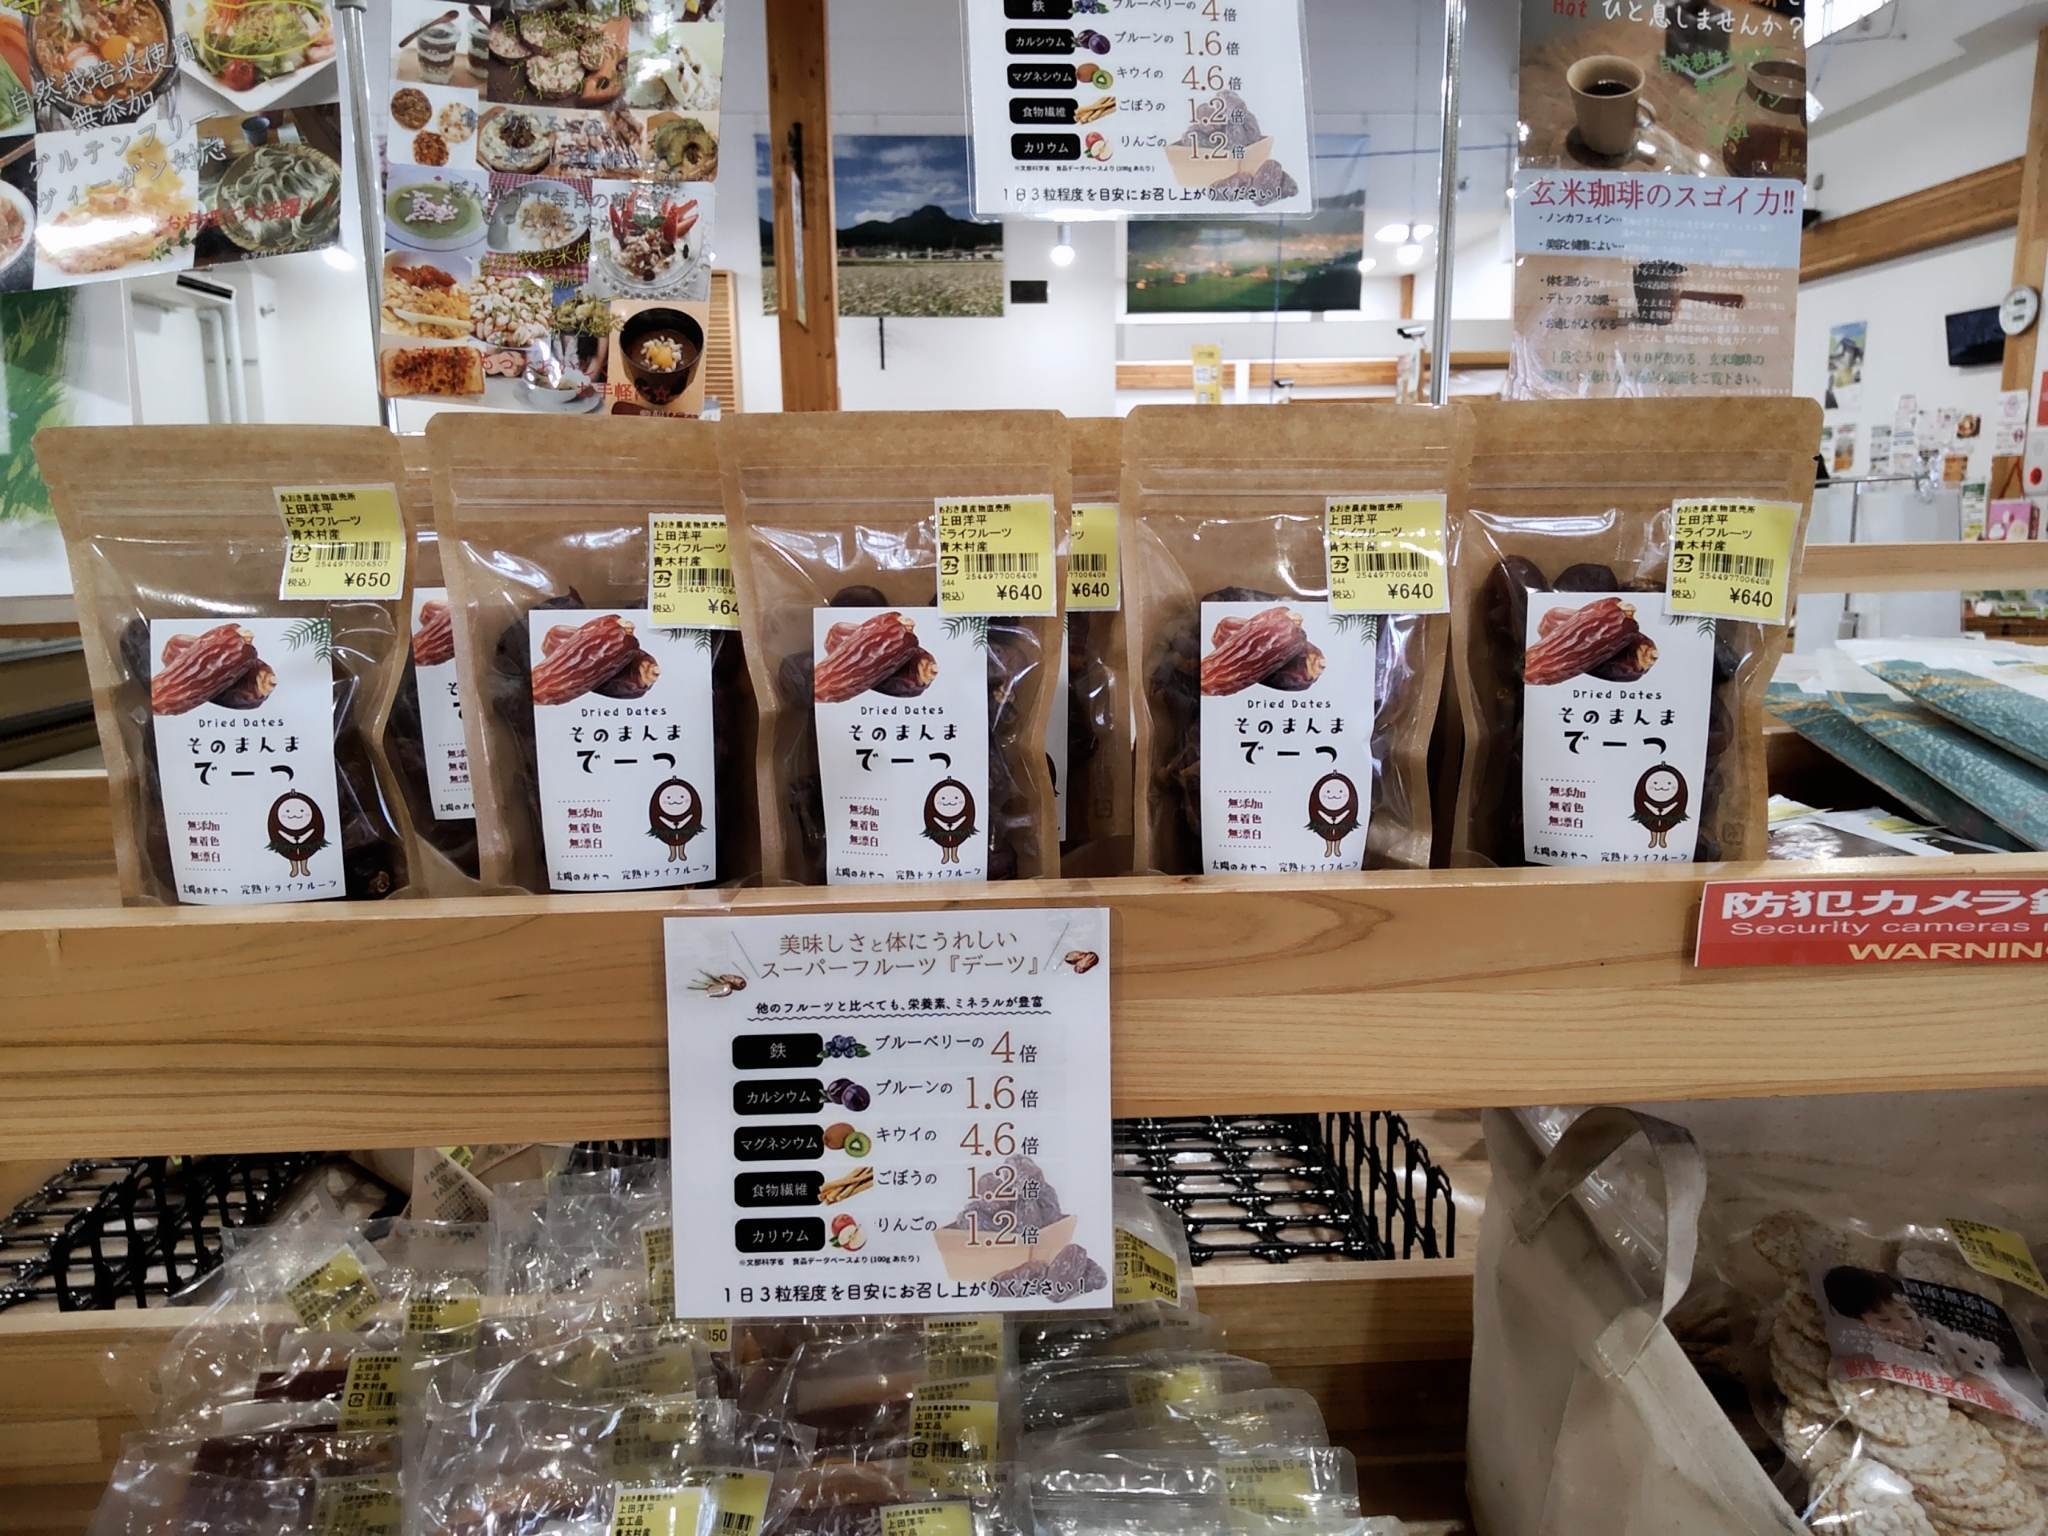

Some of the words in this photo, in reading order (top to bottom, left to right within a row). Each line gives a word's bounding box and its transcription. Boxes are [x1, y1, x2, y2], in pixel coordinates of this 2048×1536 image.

[1602, 1, 1804, 41] ひと息しませんか?
[1015, 36, 1066, 48] カルシウム
[11, 31, 196, 116] 自然栽培米使用
[1012, 70, 1073, 83] マグネシウム
[1116, 67, 1163, 79] キウイの
[71, 89, 156, 136] 無添加
[1022, 106, 1067, 118] 食物繊維
[1120, 100, 1166, 112] ごぼうの
[1024, 142, 1069, 154] カリウム
[1121, 136, 1167, 148] りんごの
[285, 503, 333, 515] 上田洋平
[287, 516, 361, 527] ドライフルーツ
[939, 515, 987, 526] 上田洋平
[1330, 514, 1378, 525] 上田洋平
[1676, 515, 1728, 526] 上田洋平
[292, 530, 340, 540] 青木村産
[654, 531, 701, 541] 上田洋平
[939, 529, 1012, 539] ドライフルーツ
[1675, 528, 1752, 540] ドライフルーツ
[654, 543, 727, 553] ドライフルーツ
[940, 541, 988, 552] 青木村産
[1674, 541, 1726, 551] 青木村産
[654, 557, 702, 567] 青木村産
[344, 572, 391, 588] ¥650
[996, 584, 1042, 601] ¥640
[1072, 582, 1110, 597] ¥640
[1388, 583, 1433, 599] ¥640
[1730, 587, 1773, 608] ¥640
[1573, 690, 1612, 699] Dried
[1619, 690, 1662, 700] Dates
[861, 706, 897, 715] Dried
[904, 706, 944, 715] Dates
[1247, 699, 1284, 709] Dried
[1292, 699, 1331, 708] Dates
[582, 708, 619, 717] Dried
[627, 707, 667, 716] Dates
[1558, 707, 1675, 725] そのまんま
[198, 719, 236, 729] Dried
[243, 718, 284, 727] Dates
[1234, 717, 1344, 734] そのまんま
[569, 725, 681, 743] そのまんま
[849, 724, 958, 741] そのまんま
[187, 736, 300, 754] そのまんま
[1564, 731, 1667, 755] でーつ
[856, 748, 952, 772] でーつ
[1240, 741, 1337, 765] でーつ
[577, 750, 676, 773] でーつ
[194, 762, 295, 785] でーつ
[1549, 786, 1586, 799] 無添加
[849, 804, 880, 817] 無添加
[1227, 798, 1263, 809] 無添加
[1548, 801, 1584, 813] 無着色
[567, 807, 603, 818] 無添加
[1227, 813, 1262, 824] 無着色
[187, 820, 220, 832] 無添加
[568, 823, 602, 833] 無着色
[849, 819, 879, 832] 無着色
[1548, 816, 1583, 829] 無漂白
[1227, 828, 1262, 840] 無漂白
[188, 836, 220, 847] 無着色
[569, 838, 603, 849] 無漂白
[849, 835, 879, 848] 無漂白
[190, 851, 221, 862] 無漂白
[1532, 845, 1588, 860] 太陽のおやつ
[1601, 851, 1688, 863] 完熟ドライフルーツ
[557, 870, 610, 881] 太陽のおやつ
[621, 865, 709, 881] 完熟ドライフルーツ
[1211, 860, 1267, 871] 太陽のおやつ
[1279, 861, 1360, 872] 完熟ドライフルーツ
[835, 868, 885, 879] 太陽のおやつ
[896, 868, 982, 880] 完熟ドライフルーツ
[183, 884, 228, 895] 太陽のおやつ
[240, 880, 337, 895] 完熟ドライフルーツ
[1730, 920, 1870, 936] Security
[1882, 920, 2030, 933] cameras
[778, 931, 1018, 955] 美味しさと体にうれしい
[1848, 943, 2048, 961] WARNIN
[760, 955, 1040, 980] スーパーフルーツ『デーツ』
[756, 996, 1043, 1015] 他のフルーツと比べても、栄養素、ミネラルが豊富
[769, 1042, 787, 1058] 鉄
[875, 1035, 983, 1051] ブルーベリーの
[746, 1089, 811, 1104] カルシウム
[740, 1136, 818, 1151] マグネシウム
[876, 1127, 937, 1142] キウイの
[752, 1182, 808, 1198] 食物繊維
[877, 1170, 937, 1186] ごぼうの
[752, 1229, 809, 1243] カリウム
[877, 1218, 937, 1232] りんごの
[724, 1280, 1087, 1305] 1日3粒程度を目安にお召し上がりください!
[1149, 1281, 1177, 1299] ¥350
